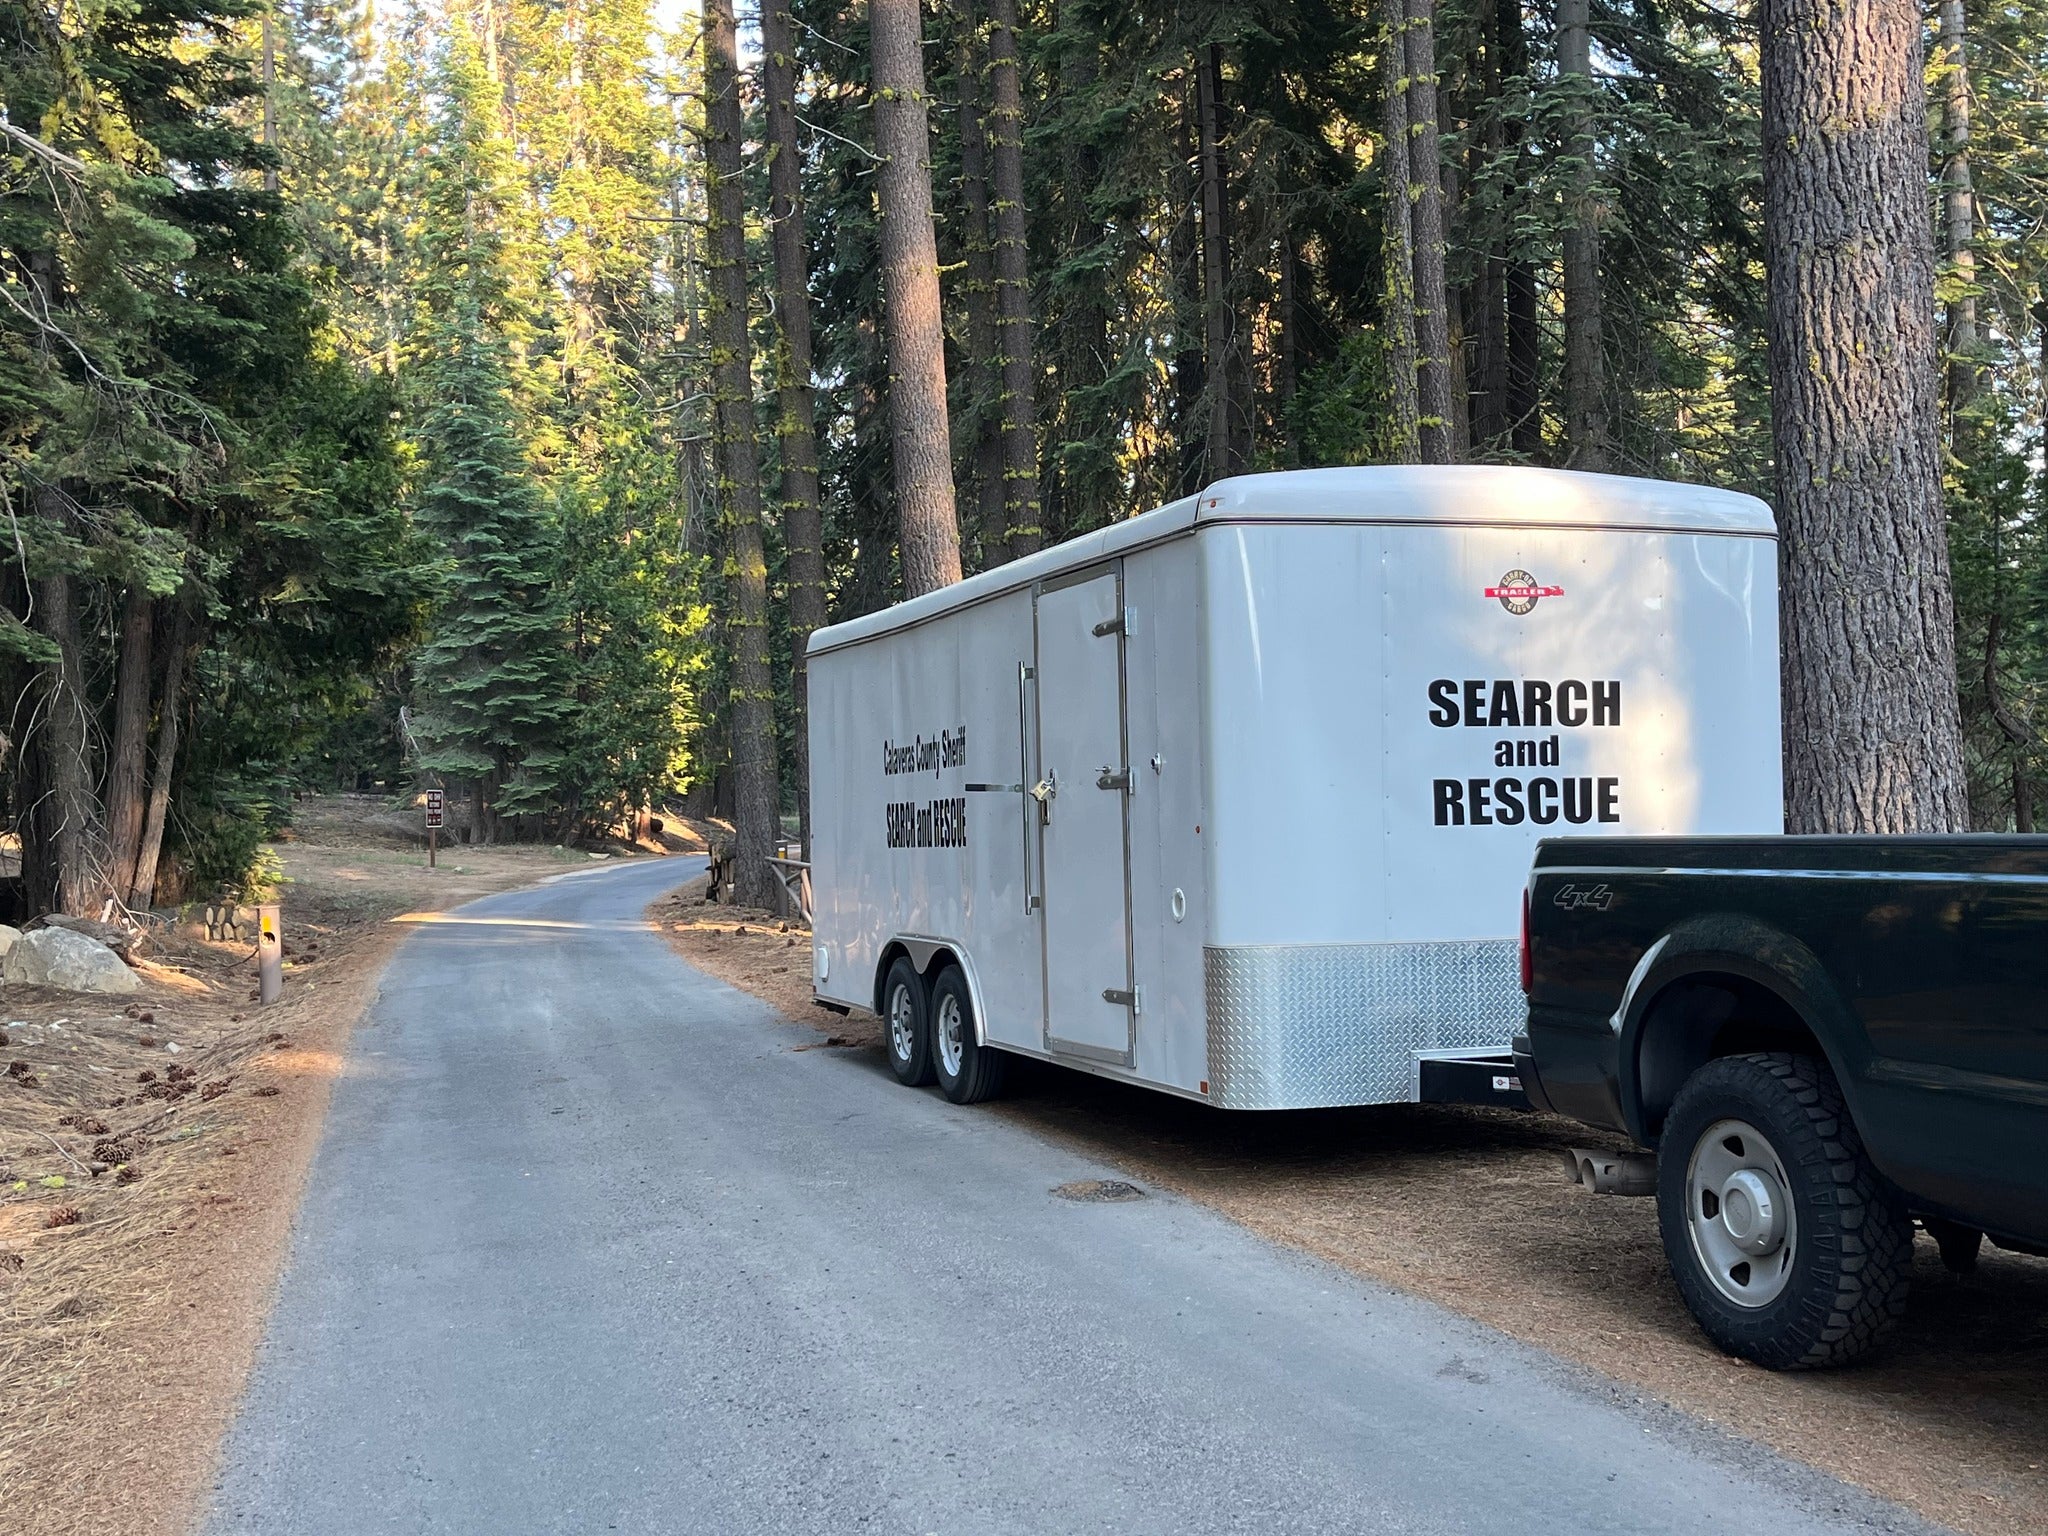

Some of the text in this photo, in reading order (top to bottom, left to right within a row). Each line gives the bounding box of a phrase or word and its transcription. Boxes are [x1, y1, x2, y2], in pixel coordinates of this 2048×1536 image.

[1503, 571, 1534, 585] CARRY-ON
[1508, 602, 1531, 613] CARGO
[1428, 679, 1621, 727] SEARCH
[884, 725, 966, 779] Calaveras County Sheriff
[1494, 735, 1559, 767] and
[1433, 777, 1620, 826] RESCUE
[887, 797, 967, 849] SEARCH and RESCUE
[1553, 884, 1614, 910] 4x4
